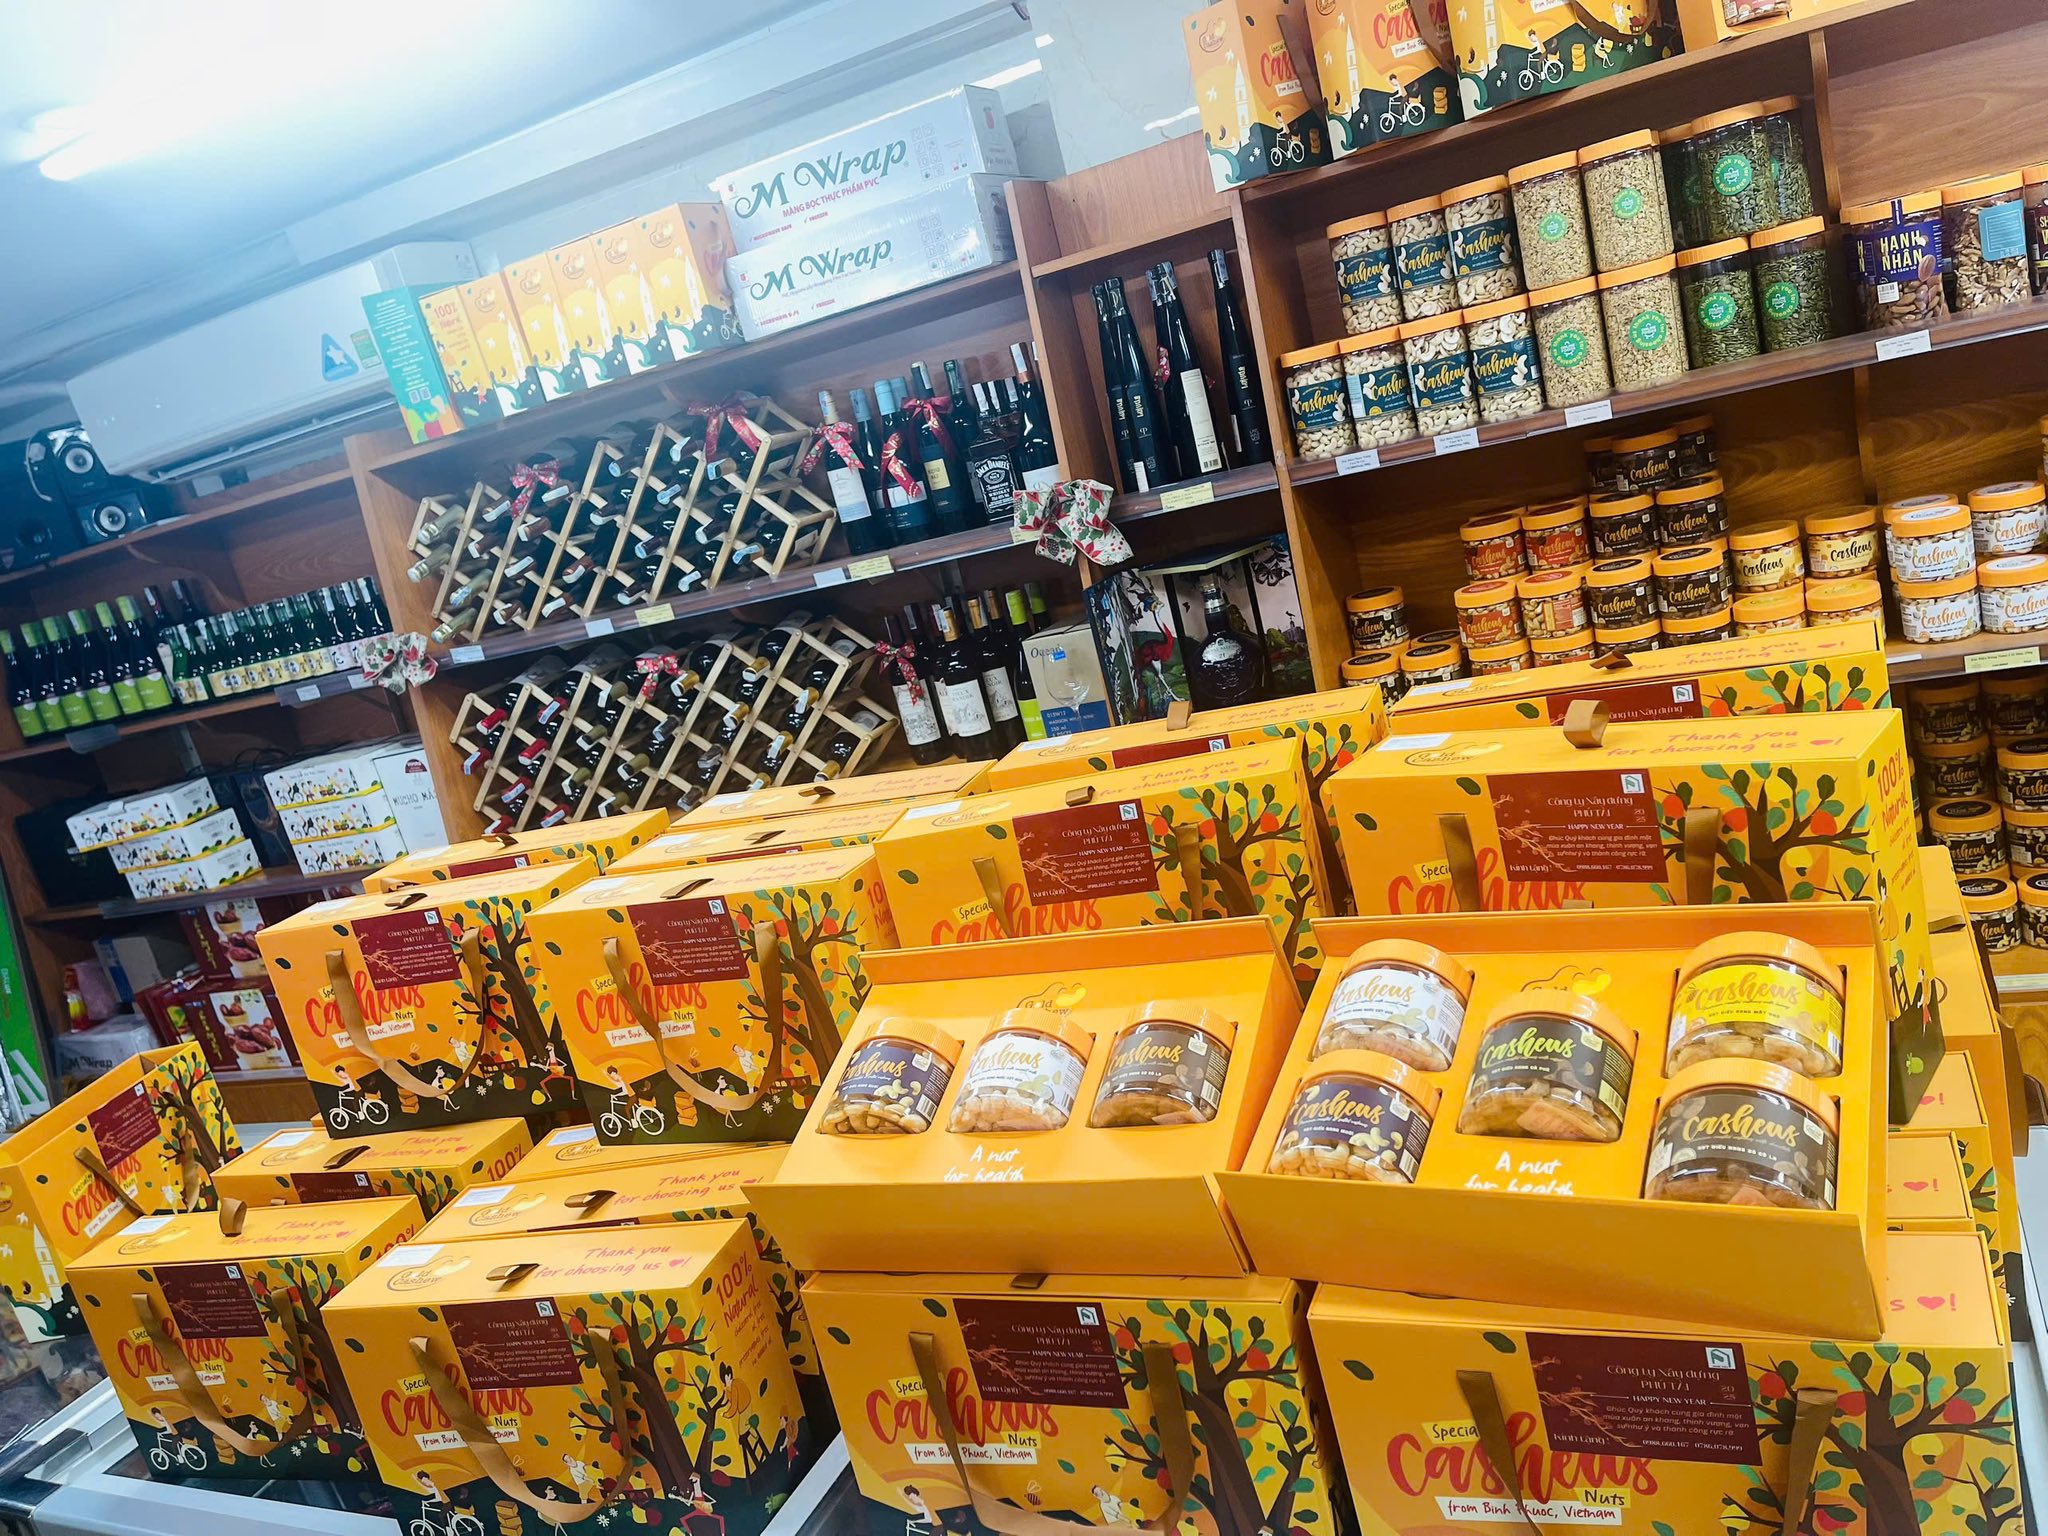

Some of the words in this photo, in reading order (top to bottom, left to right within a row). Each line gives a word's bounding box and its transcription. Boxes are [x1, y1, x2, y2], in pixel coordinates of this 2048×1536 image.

[734, 172, 789, 219] M
[793, 139, 906, 189] Wrap
[783, 205, 805, 217] MÀNG
[806, 198, 821, 211] BỌC
[820, 193, 842, 205] THỰC
[864, 177, 879, 190] PVC
[1880, 230, 1921, 253] HẠNH
[1882, 248, 1923, 271] NHÂN
[750, 263, 795, 300] M
[799, 239, 892, 278] Wrap
[976, 463, 990, 478] JACK
[987, 460, 1010, 470] DANIEL'S
[1667, 732, 1746, 744] Thank
[1754, 729, 1799, 743] you
[1606, 746, 1646, 758] for
[1649, 741, 1756, 757] choosing
[1768, 739, 1798, 749] us
[1877, 748, 1905, 802] 100%
[392, 793, 418, 806] MUCHO
[1548, 797, 1573, 807] Công
[395, 1011, 414, 1020] Nuts
[674, 1011, 694, 1022] Nuts
[611, 1032, 626, 1044] from
[666, 1023, 692, 1033] Vietnam
[970, 1145, 984, 1163] A
[986, 1148, 1020, 1163] nut
[1495, 1151, 1511, 1172] A
[1518, 1159, 1564, 1176] nut
[658, 1173, 706, 1187] Thank
[708, 1169, 741, 1183] you
[613, 1194, 637, 1206] for
[638, 1187, 711, 1203] choosing
[718, 1182, 735, 1191] us
[585, 1247, 636, 1259] Thank
[638, 1245, 672, 1256] you
[534, 1266, 563, 1279] for
[565, 1262, 641, 1278] choosing
[643, 1261, 660, 1270] us
[716, 1250, 752, 1306] 100%
[723, 1274, 759, 1328] Natural
[1607, 1365, 1639, 1376] Công
[1686, 1369, 1720, 1381] dựng
[1632, 1395, 1661, 1403] HAPPY
[1645, 1407, 1670, 1416] khách
[1655, 1416, 1681, 1425] khang,
[495, 1416, 518, 1427] Nuts
[1007, 1433, 1038, 1447] Nuts
[1432, 1424, 1480, 1441] Specia
[422, 1436, 440, 1448] from
[914, 1446, 936, 1460] from
[961, 1447, 993, 1460] Phuoc,
[994, 1448, 1033, 1459] Vietnam
[1584, 1488, 1625, 1506] Nuts
[1447, 1502, 1478, 1520] from
[1483, 1502, 1510, 1516] Binh
[1563, 1505, 1616, 1519] Vietnam
